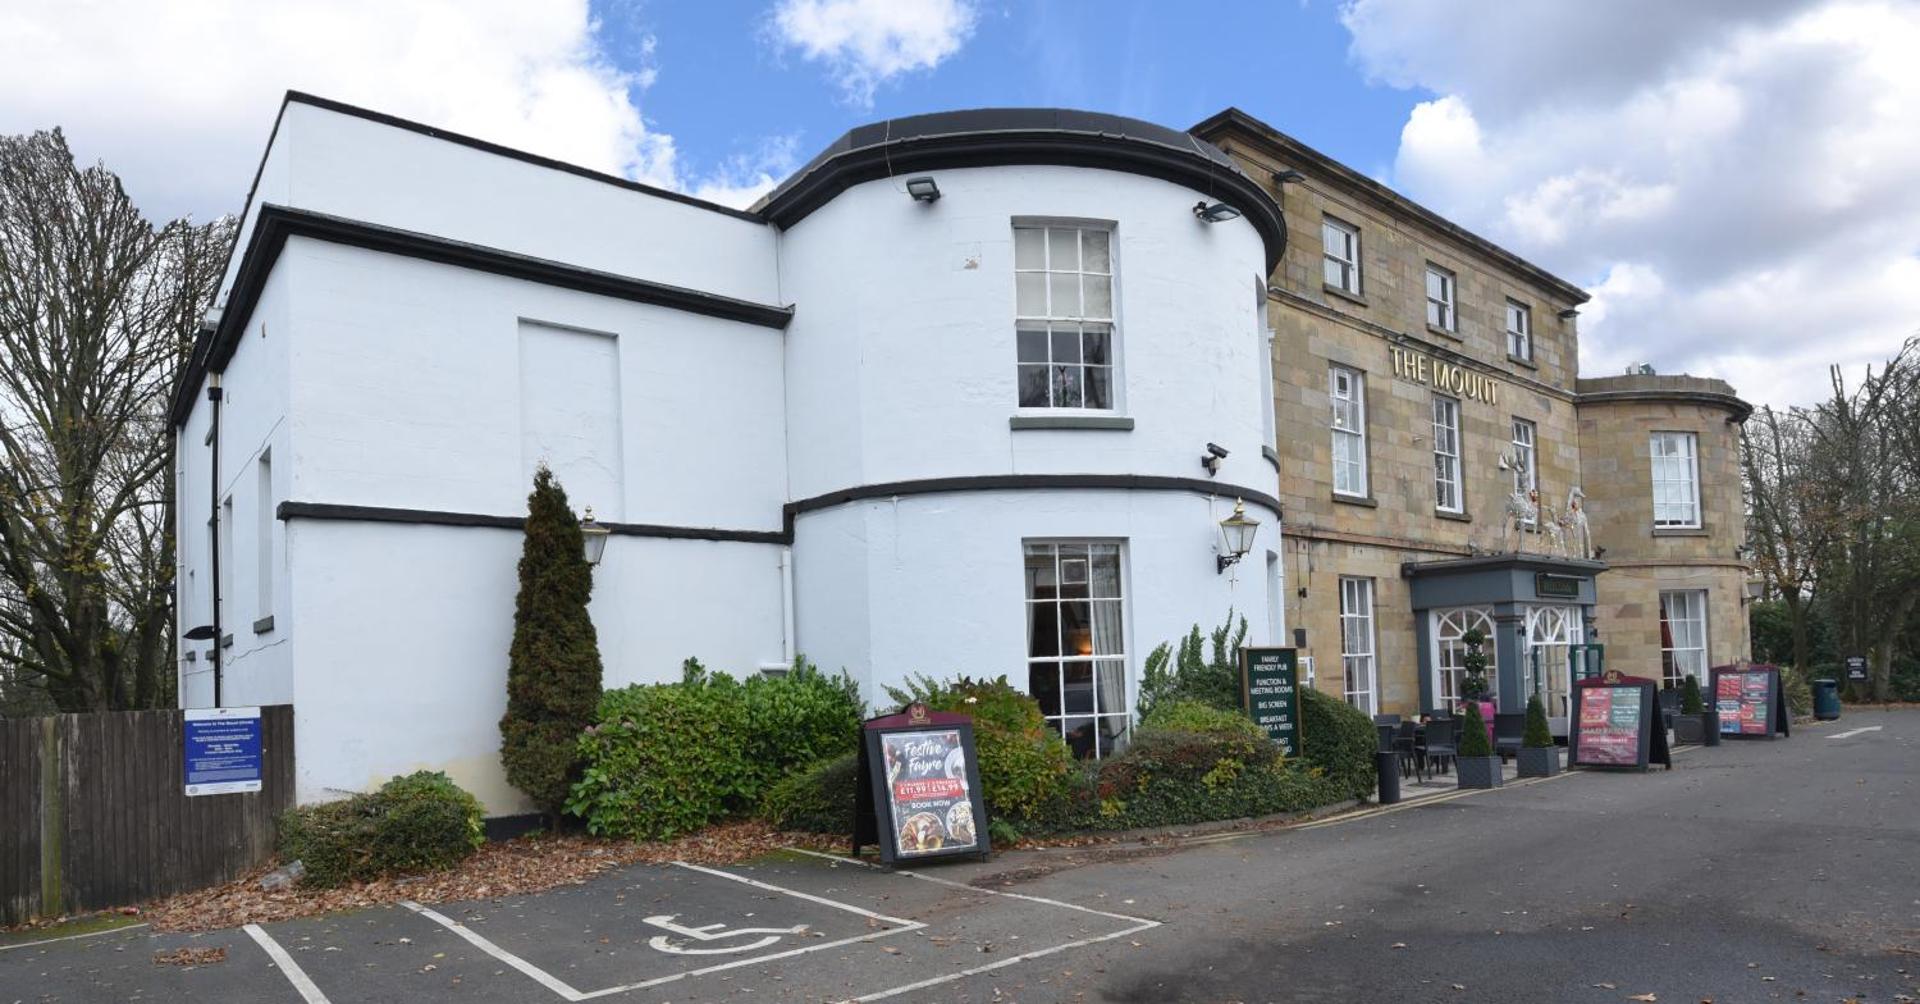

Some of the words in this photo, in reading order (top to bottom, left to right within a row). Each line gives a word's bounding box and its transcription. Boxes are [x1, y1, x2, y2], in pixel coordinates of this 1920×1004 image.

[1389, 345, 1428, 384] THE
[1432, 360, 1498, 406] MOUNT
[1256, 678, 1281, 686] FUNCTION
[1250, 687, 1273, 695] MEETING
[1274, 686, 1293, 694] ROOMS
[1258, 701, 1267, 709] BIG
[1260, 715, 1288, 723] BREAKFAST
[904, 740, 942, 758] Festive
[909, 757, 942, 776] Fayre
[911, 801, 932, 809] BOOK
